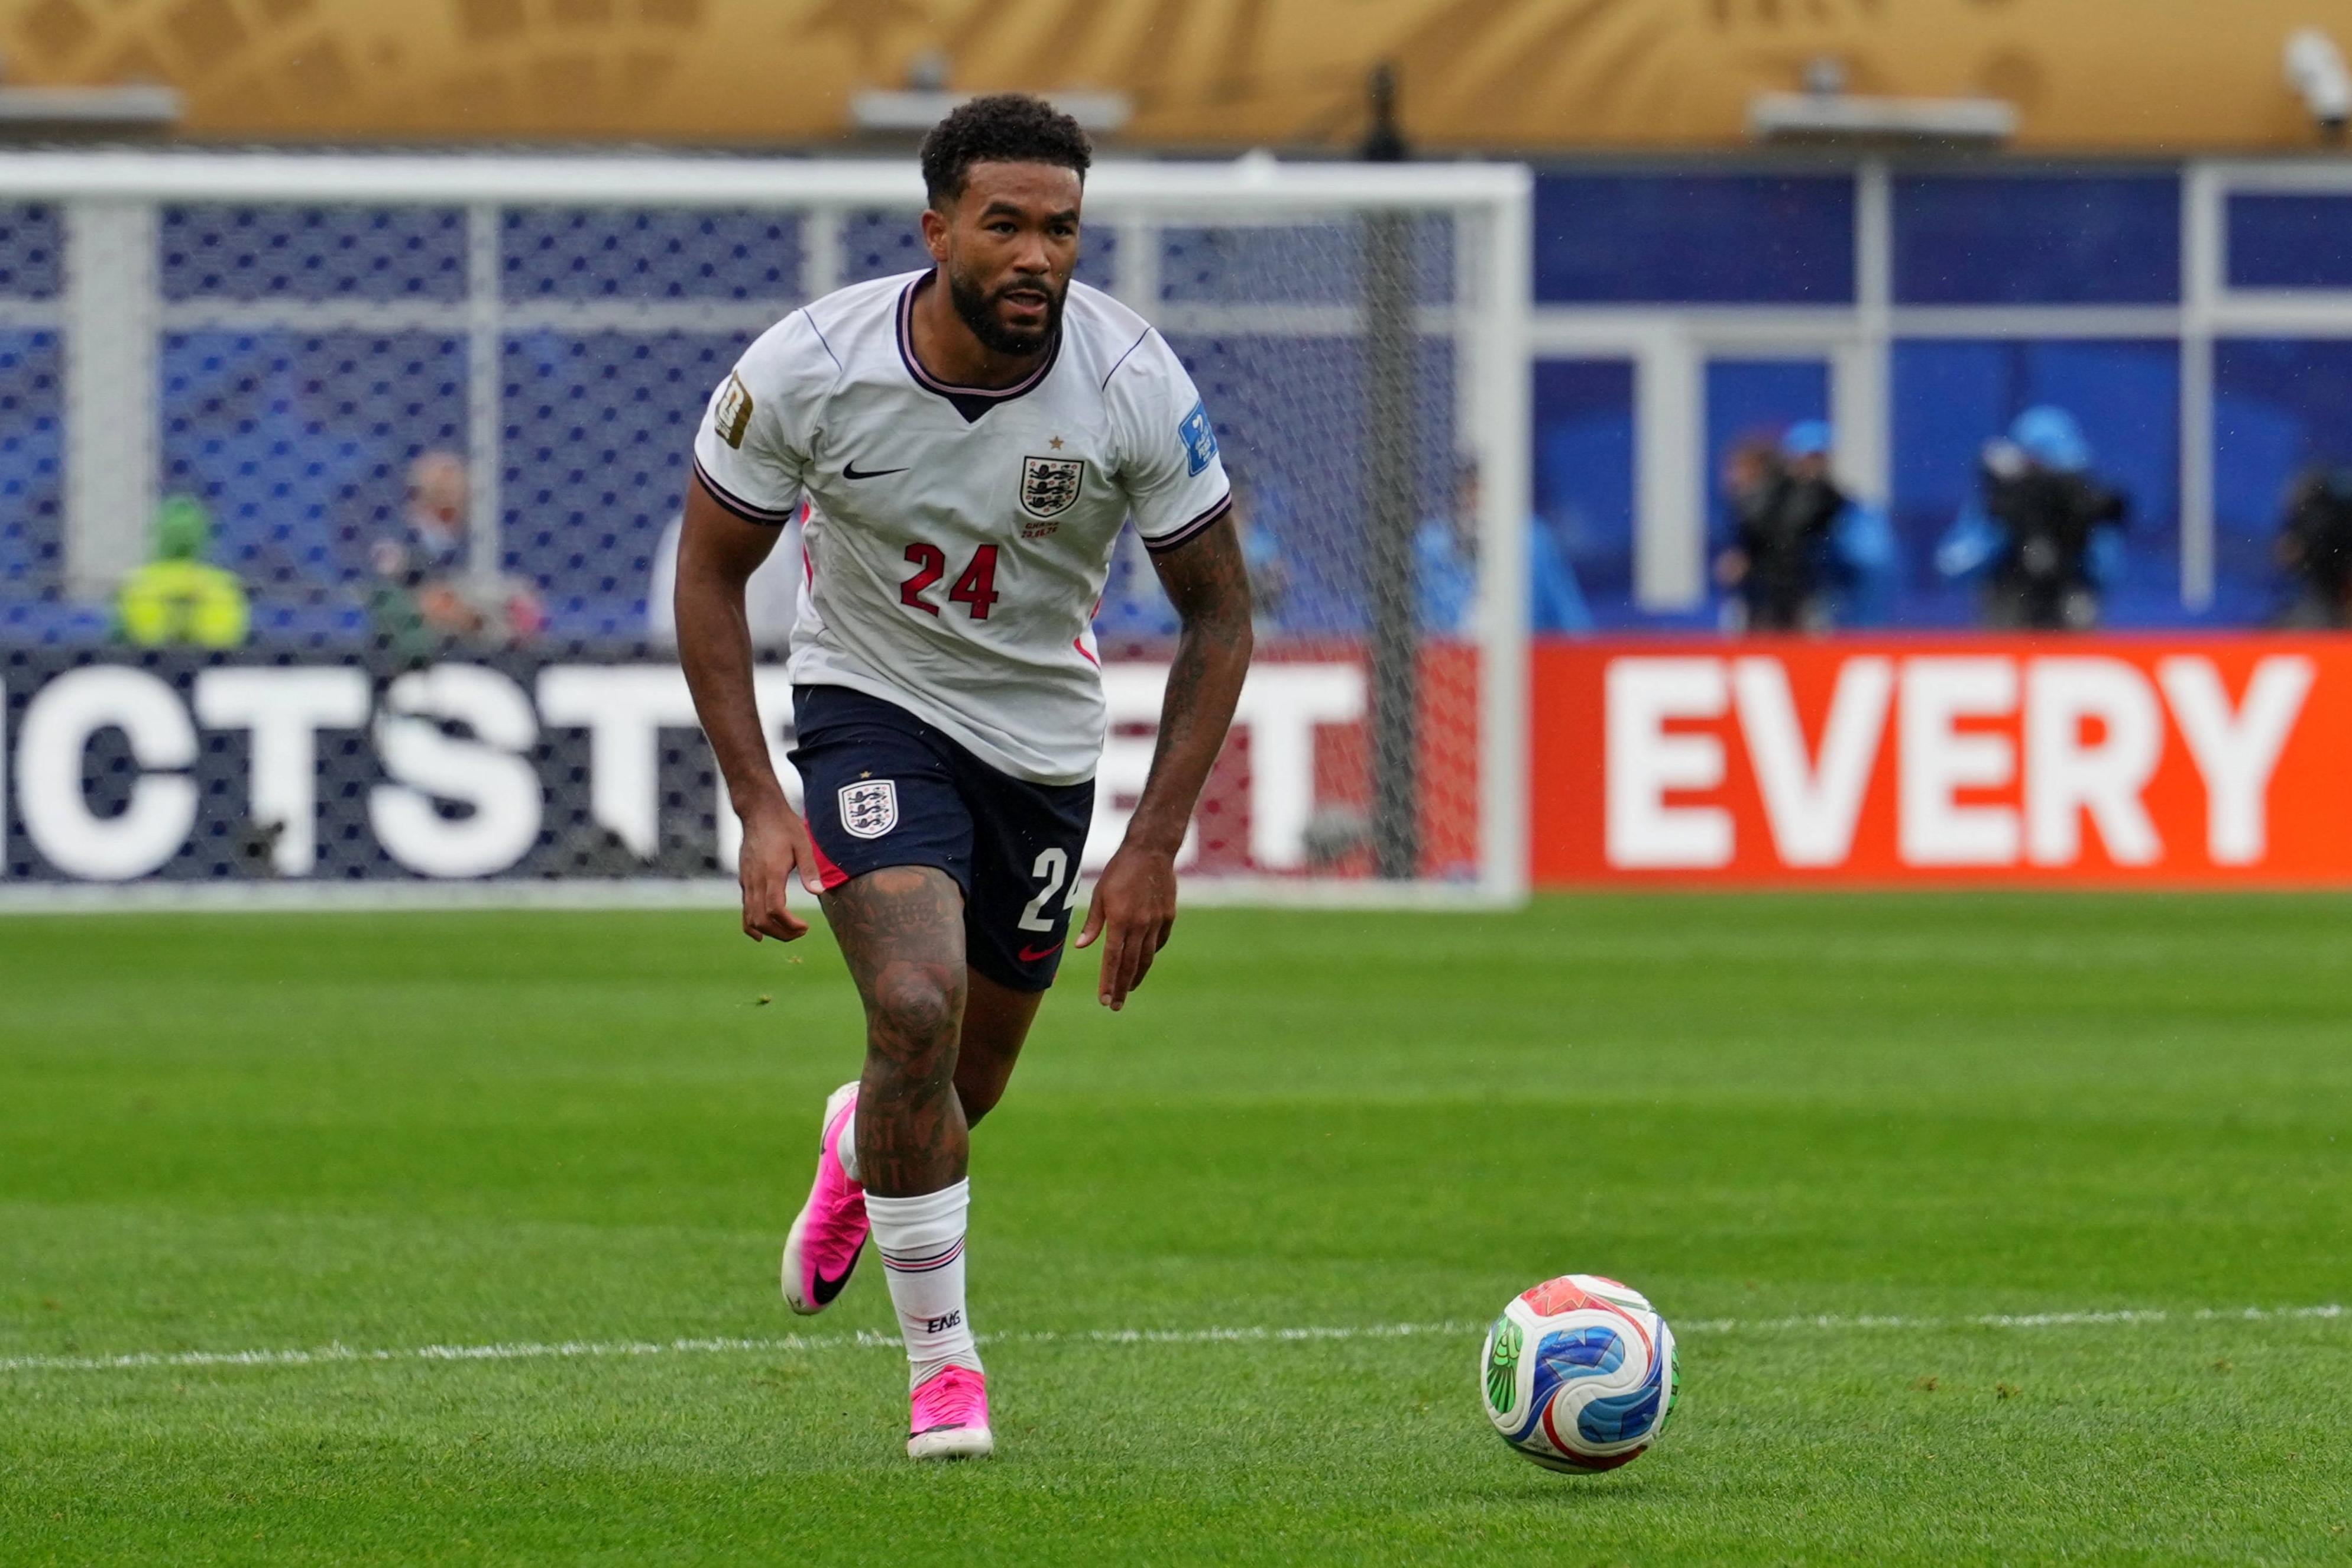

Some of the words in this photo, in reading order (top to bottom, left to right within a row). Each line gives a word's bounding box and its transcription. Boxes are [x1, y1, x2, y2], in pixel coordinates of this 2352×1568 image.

[900, 542, 1000, 620] 24
[1604, 655, 2315, 869] EVERY
[927, 1309, 961, 1334] ENG
